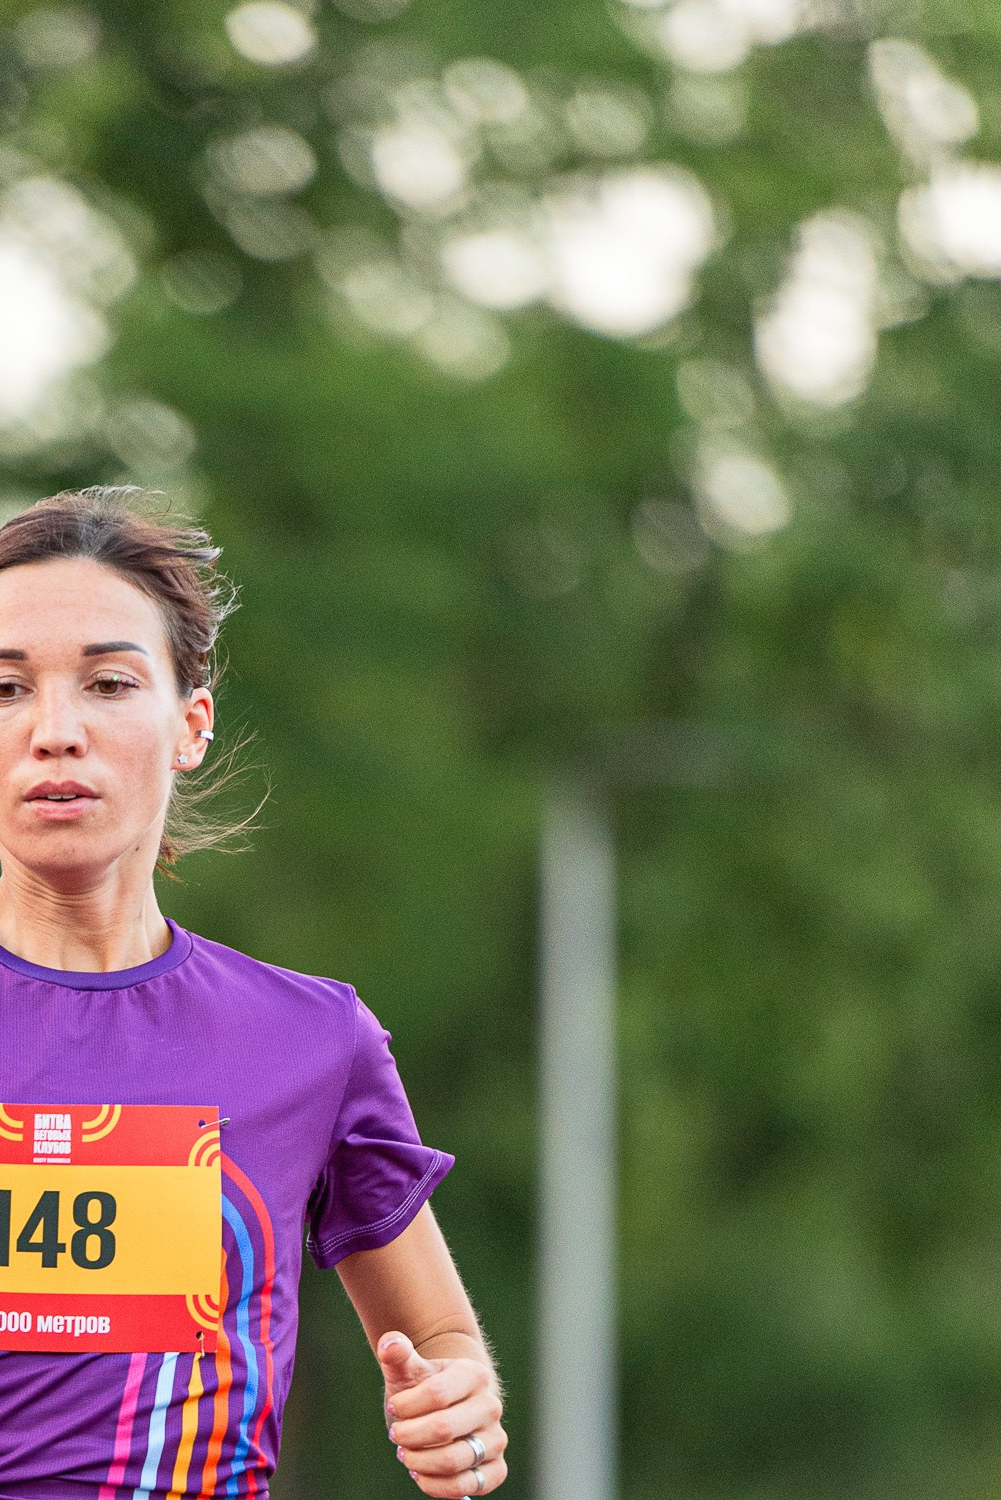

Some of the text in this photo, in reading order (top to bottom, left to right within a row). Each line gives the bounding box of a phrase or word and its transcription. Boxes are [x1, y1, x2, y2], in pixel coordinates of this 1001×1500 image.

[34, 1113, 71, 1130] БИТВА
[33, 1141, 71, 1154] КЛУБОВ
[36, 1314, 111, 1337] метров
